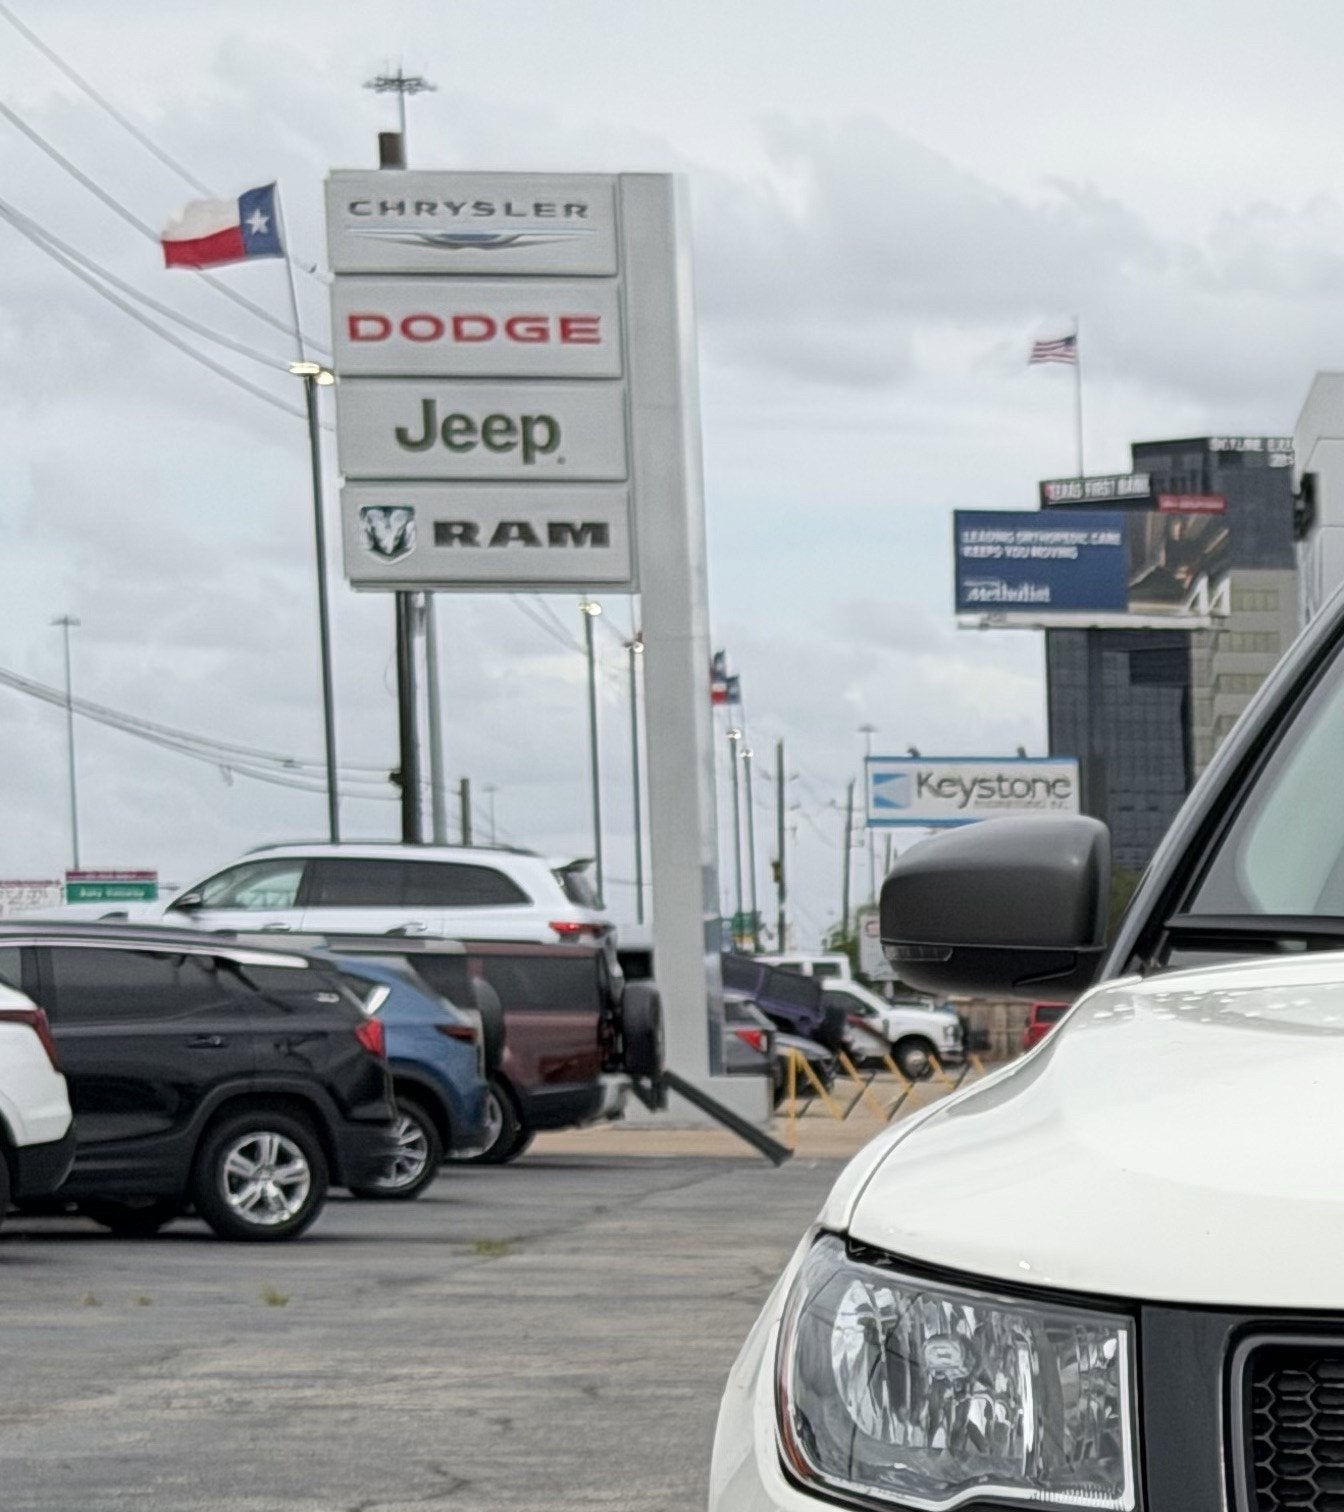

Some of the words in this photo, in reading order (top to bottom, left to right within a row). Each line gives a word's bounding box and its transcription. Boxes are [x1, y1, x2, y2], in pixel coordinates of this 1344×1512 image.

[348, 199, 589, 219] CHRYSLER
[347, 313, 603, 344] DODGE
[394, 398, 563, 465] Jeep
[433, 520, 611, 549] RAM
[916, 771, 1072, 809] Keystone
